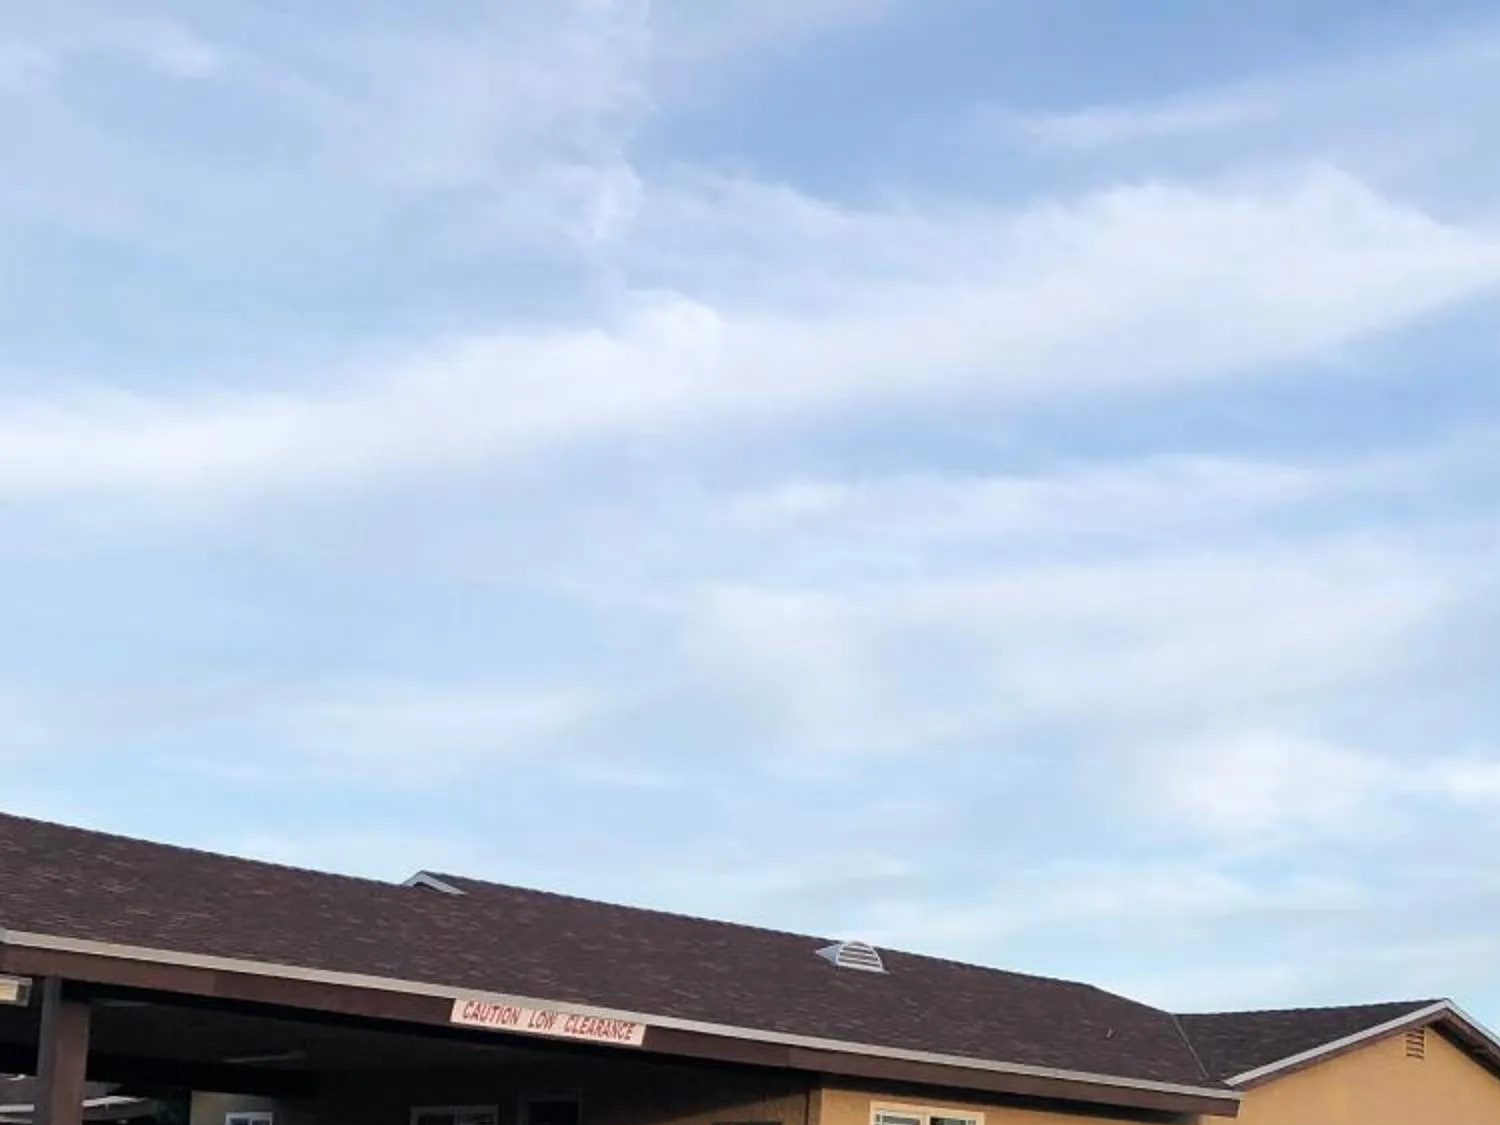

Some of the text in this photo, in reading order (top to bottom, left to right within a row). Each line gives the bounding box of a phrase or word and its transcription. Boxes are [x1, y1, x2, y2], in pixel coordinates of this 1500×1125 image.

[462, 1001, 637, 1041] CAUTION LOW CLEARANCE
